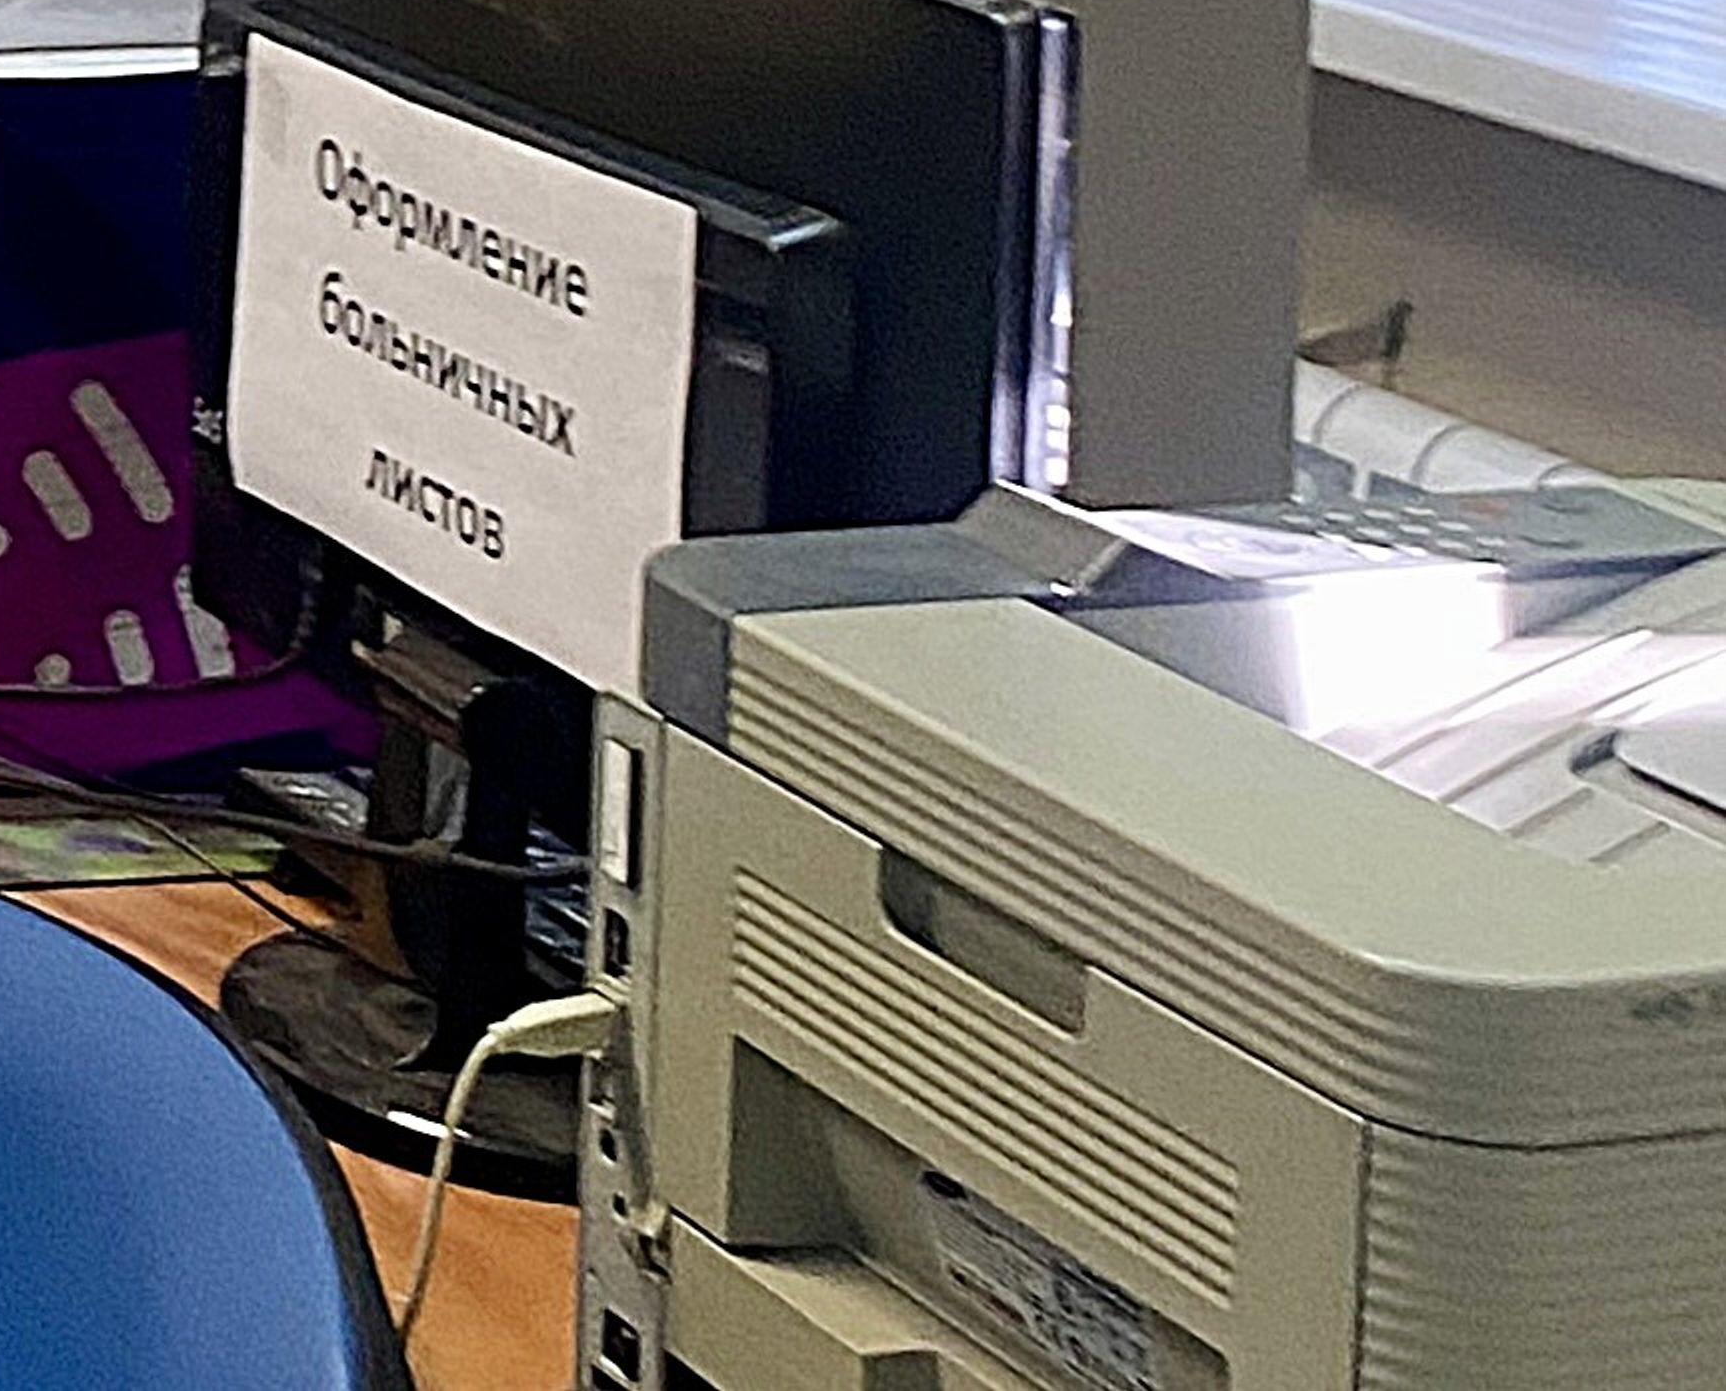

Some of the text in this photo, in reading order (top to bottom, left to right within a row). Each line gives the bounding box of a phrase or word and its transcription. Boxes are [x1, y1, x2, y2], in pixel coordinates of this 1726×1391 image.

[313, 138, 591, 318] Оформление
[318, 270, 580, 459] больничных
[366, 449, 506, 560] листов
